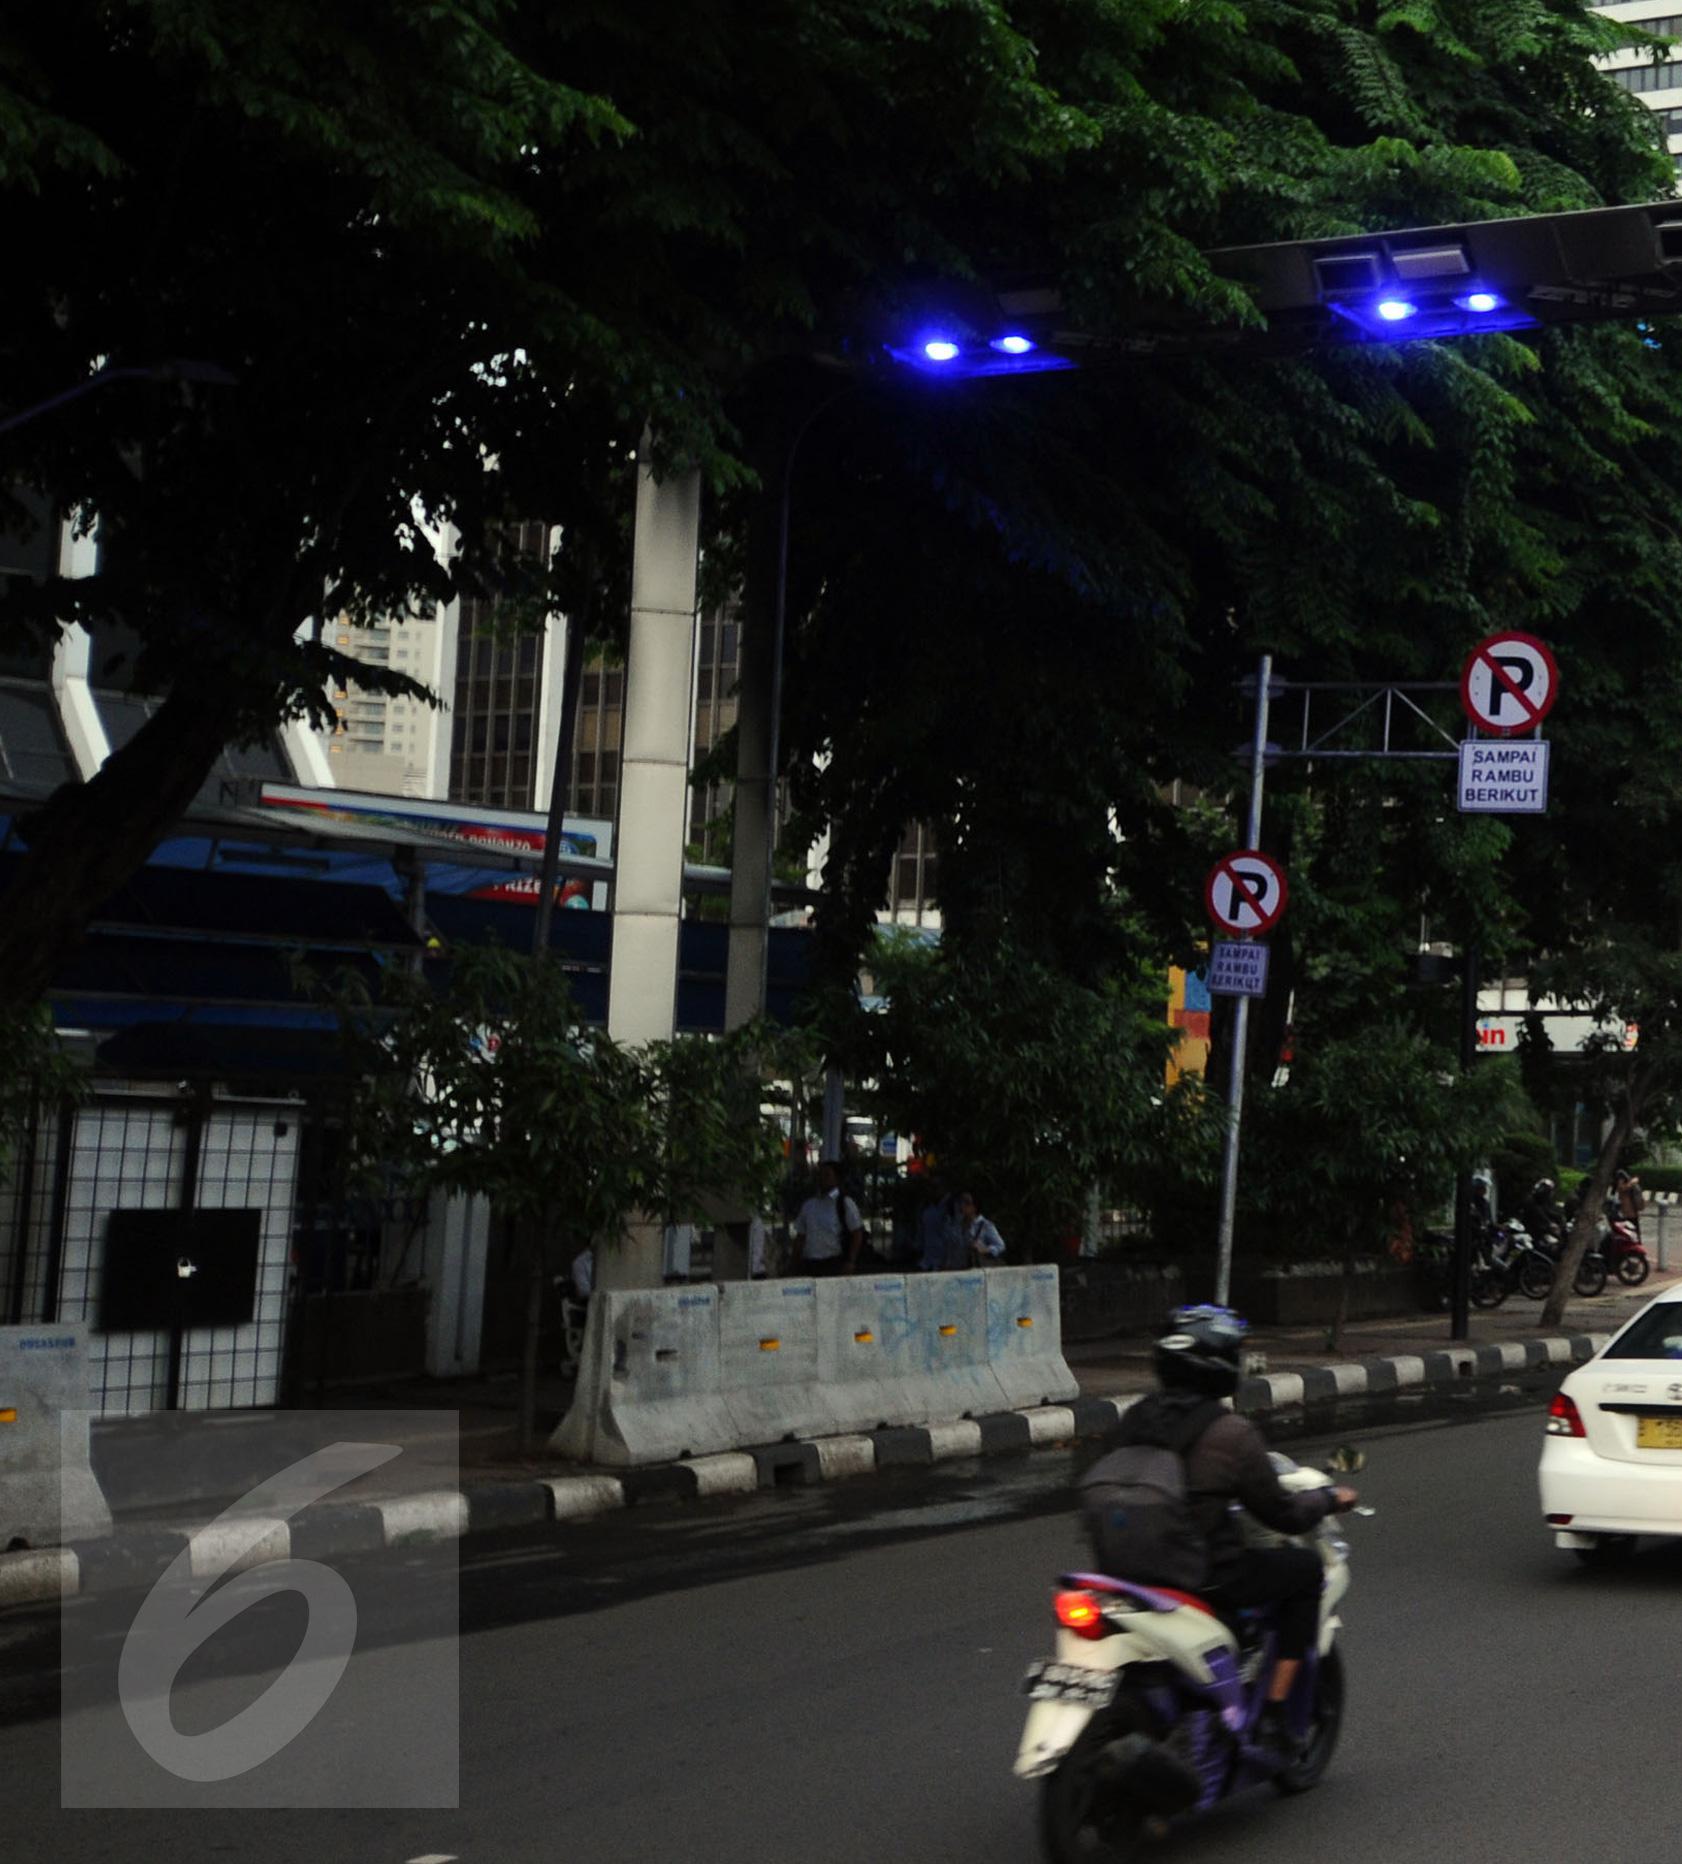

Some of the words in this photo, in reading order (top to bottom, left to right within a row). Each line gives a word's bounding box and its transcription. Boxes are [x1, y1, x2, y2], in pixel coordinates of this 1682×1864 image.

[1489, 656, 1535, 716] P
[1473, 750, 1537, 763] SAMPAI
[1471, 769, 1534, 783] RAMBU
[1465, 788, 1538, 802] BERIKUT
[1228, 871, 1268, 921] P
[1220, 946, 1260, 959] SAMPAI
[1217, 960, 1258, 975] RAMBU
[1211, 974, 1260, 990] BERIKUT
